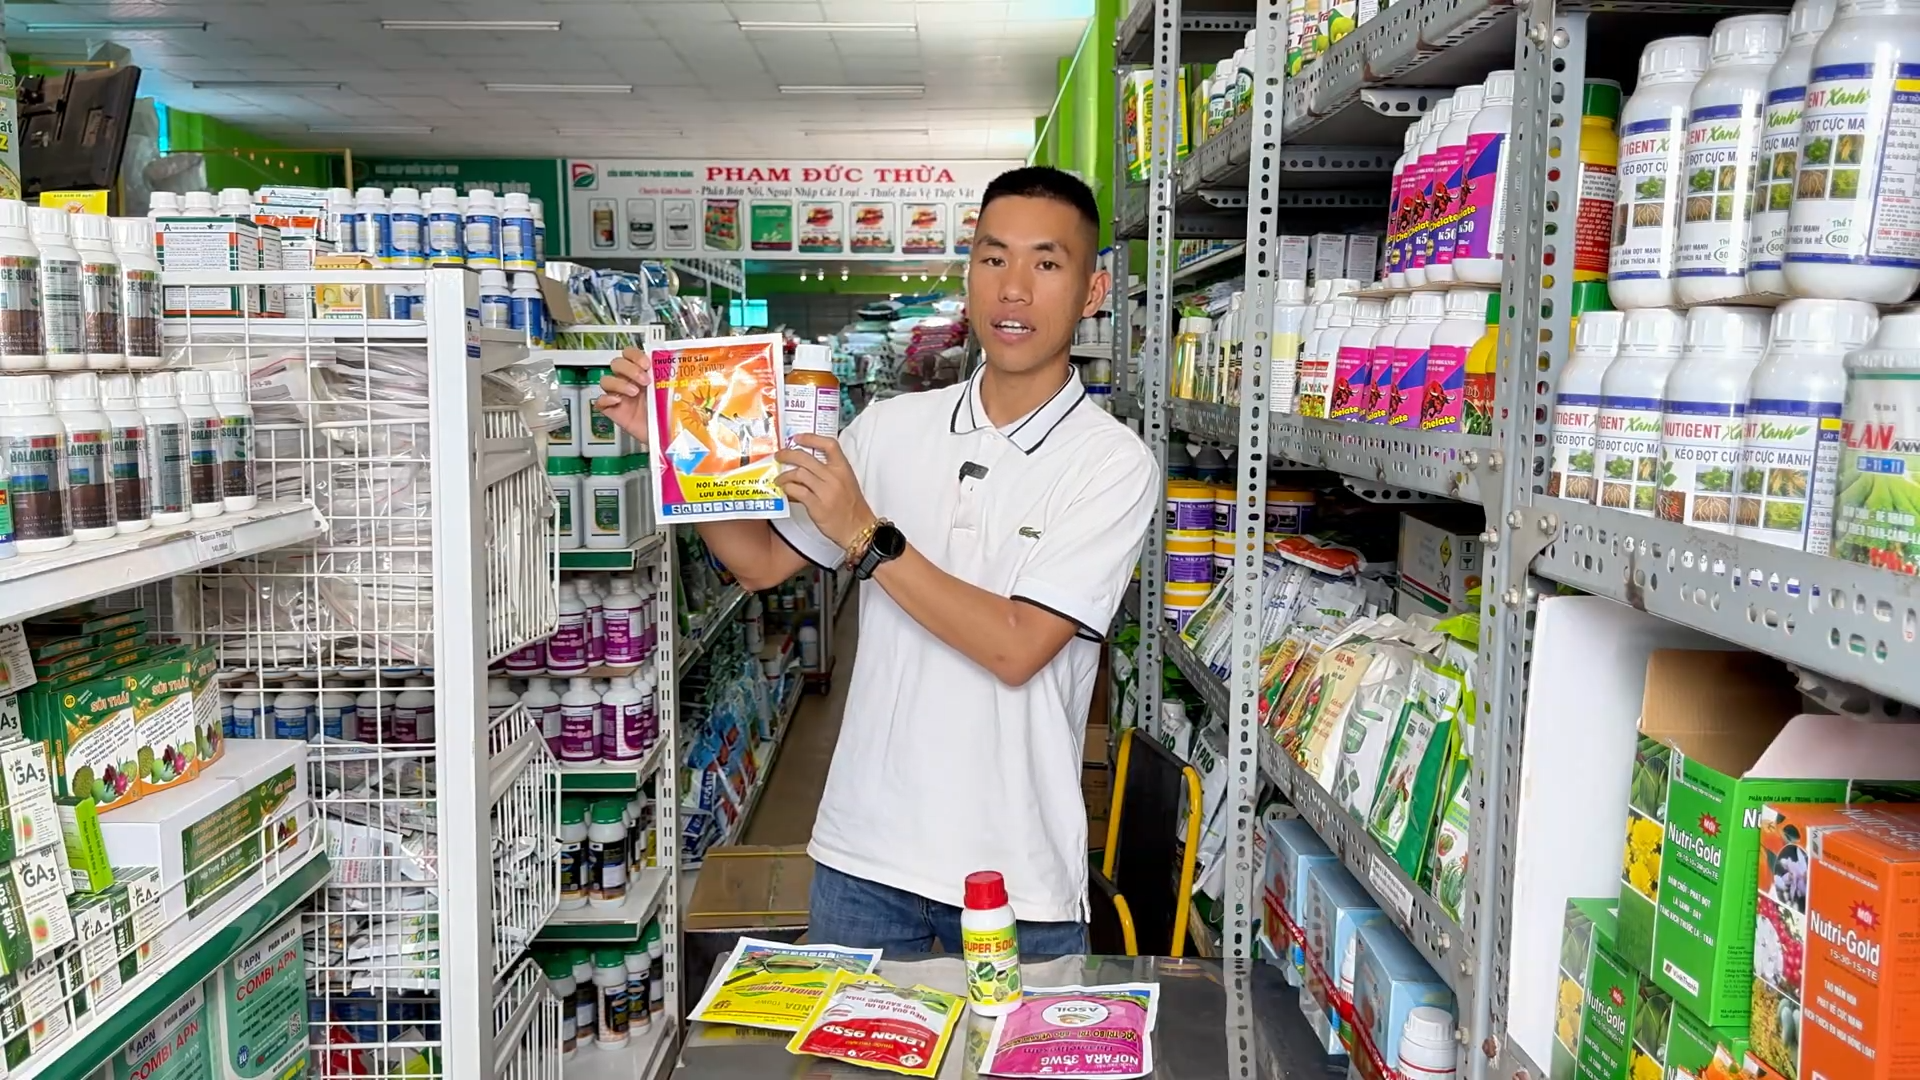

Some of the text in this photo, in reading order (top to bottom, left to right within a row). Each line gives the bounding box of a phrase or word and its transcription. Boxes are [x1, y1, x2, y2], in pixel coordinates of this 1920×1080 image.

[0, 119, 13, 134] at
[705, 164, 955, 185] PHẠM ĐỨC THỪA
[1636, 162, 1653, 174] ĐỌT
[1407, 220, 1430, 237] Chelat
[15, 269, 33, 281] SOIL
[94, 275, 112, 286] SOIL
[654, 355, 676, 364] THUỐC
[694, 354, 709, 362] SÂU
[790, 399, 806, 409] SÂU
[1331, 406, 1359, 419] Chelate
[221, 427, 238, 437] SOIL
[1421, 416, 1456, 431] Chelate
[1664, 421, 1721, 439] NUTIGENT
[1757, 421, 1796, 441] Xanh
[191, 429, 219, 440] BALANCE
[1569, 435, 1586, 447] ĐỌT
[10, 449, 55, 463] BALANCE
[1623, 441, 1644, 455] CỰC
[1675, 446, 1718, 463] KÉO ĐỌT
[1755, 450, 1811, 467] CỰC MẠNH
[168, 675, 190, 692] THÁI
[107, 690, 130, 708] THÁI
[13, 763, 47, 786] GA3
[1668, 820, 1721, 869] Nutri-Gold
[23, 864, 57, 888] GA3
[964, 937, 1014, 954] SUPER 500
[1810, 909, 1880, 968] Nutri-Gold
[236, 948, 297, 1001] COMBI APN
[785, 1002, 815, 1012] NDA
[1585, 987, 1626, 1035] Nutri-Gold
[175, 1019, 199, 1051] APN
[822, 1024, 926, 1049] LEDAN 95SP
[1040, 1053, 1139, 1066] NOFARA 35WG
